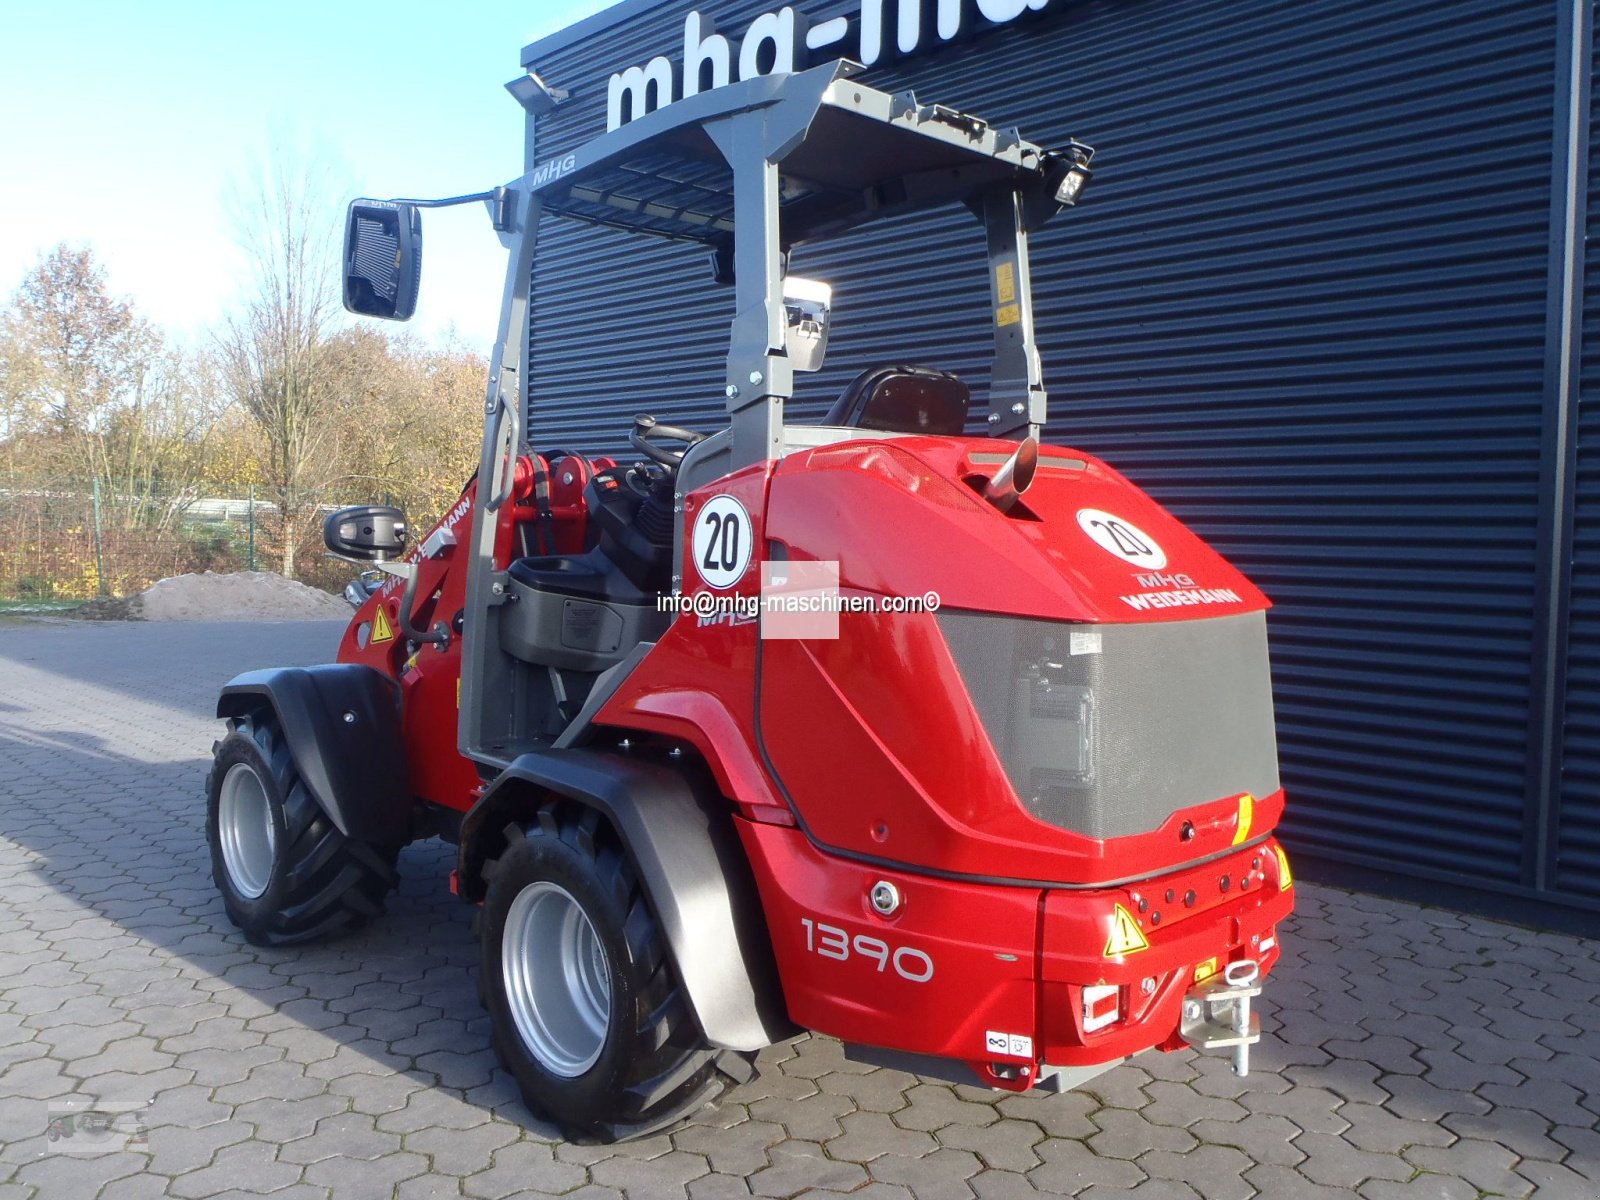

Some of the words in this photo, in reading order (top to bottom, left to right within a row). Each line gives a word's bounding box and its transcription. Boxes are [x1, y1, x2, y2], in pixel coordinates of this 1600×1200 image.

[533, 155, 576, 187] MHG
[703, 512, 739, 572] 20
[1091, 520, 1153, 556] 20
[1137, 571, 1196, 589] MHG
[1119, 588, 1243, 610] WEIDEMANN
[801, 918, 934, 983] 1390
